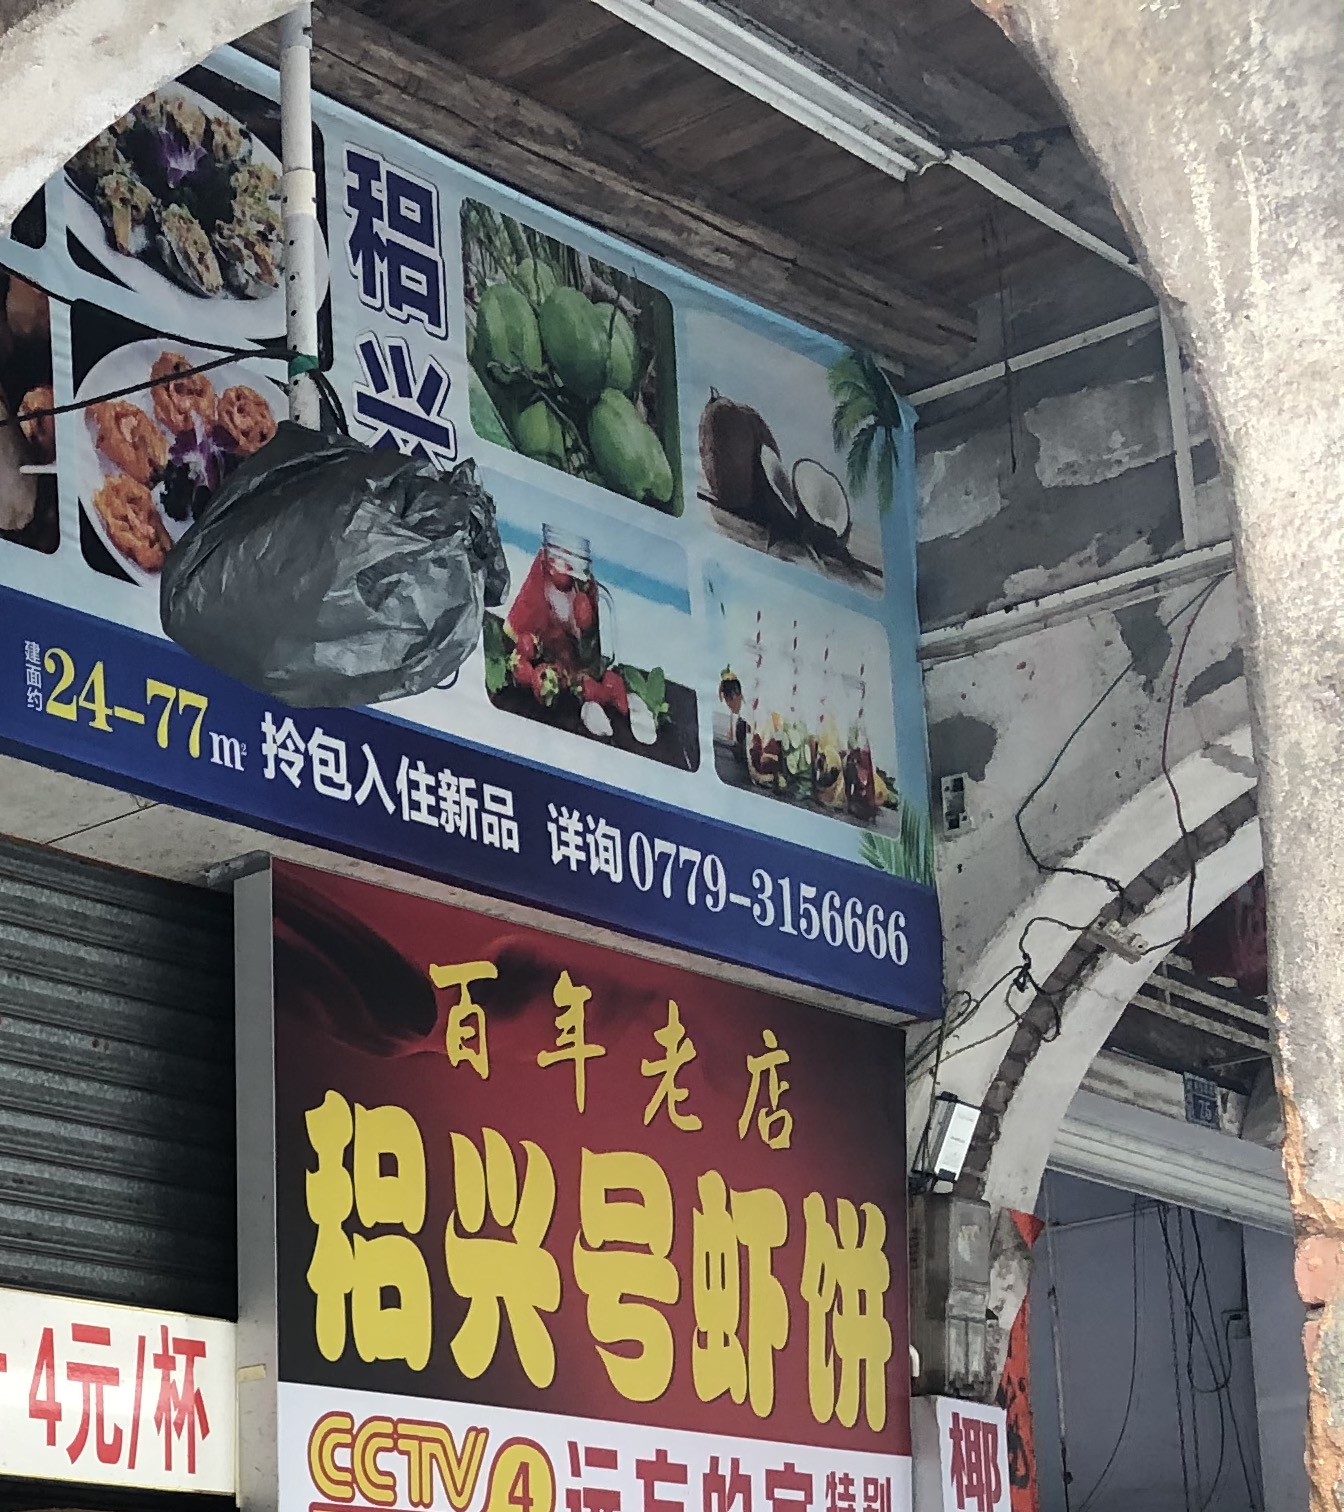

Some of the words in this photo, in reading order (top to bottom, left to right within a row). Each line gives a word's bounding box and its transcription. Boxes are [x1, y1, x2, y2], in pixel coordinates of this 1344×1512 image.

[260, 711, 520, 853] 拎包入住新品
[429, 960, 796, 1150] 百年老店
